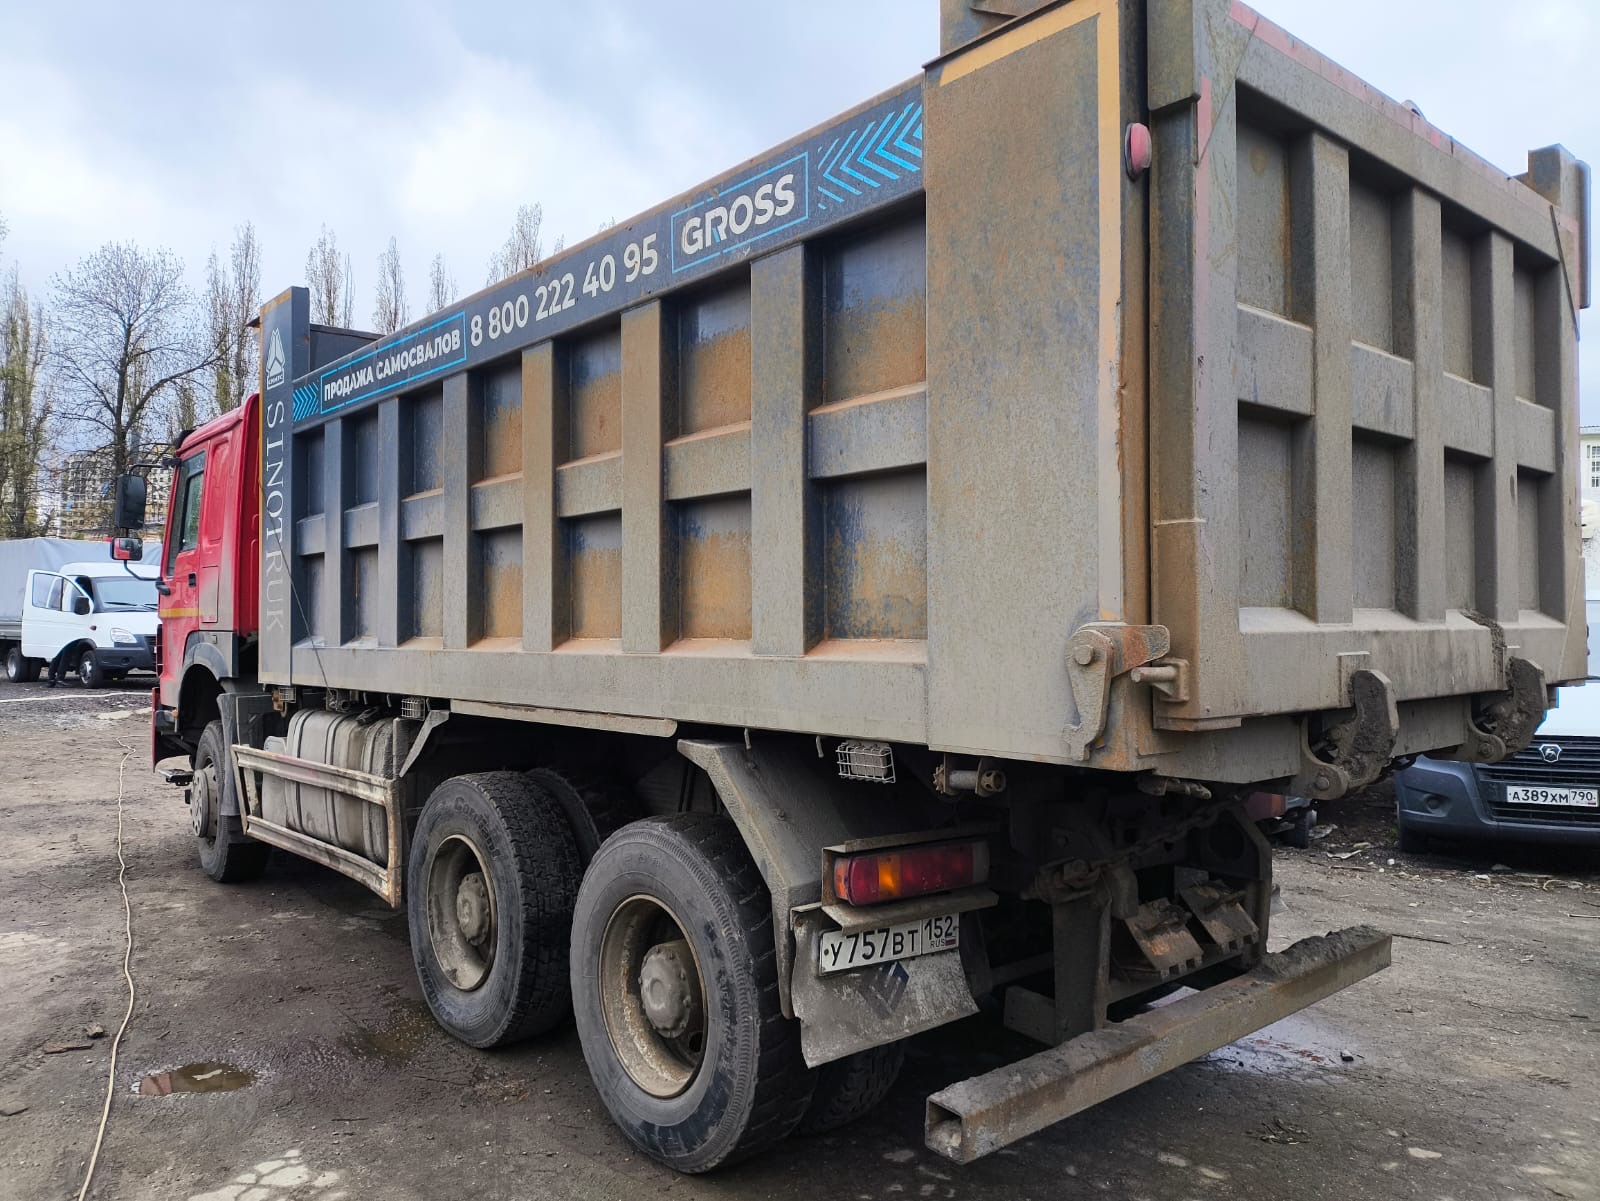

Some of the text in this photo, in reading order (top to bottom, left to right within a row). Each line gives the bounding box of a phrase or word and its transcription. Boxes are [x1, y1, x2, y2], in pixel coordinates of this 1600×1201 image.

[681, 174, 795, 255] GROSS
[470, 233, 658, 347] 8 800 222 40 95
[324, 329, 461, 401] ПРОДАЖА САМОСВАЛОВ
[266, 400, 285, 631] SINOTRUK
[1570, 790, 1593, 801] 790
[830, 916, 953, 966] У757ВТ 152
[930, 939, 945, 949] RUS
